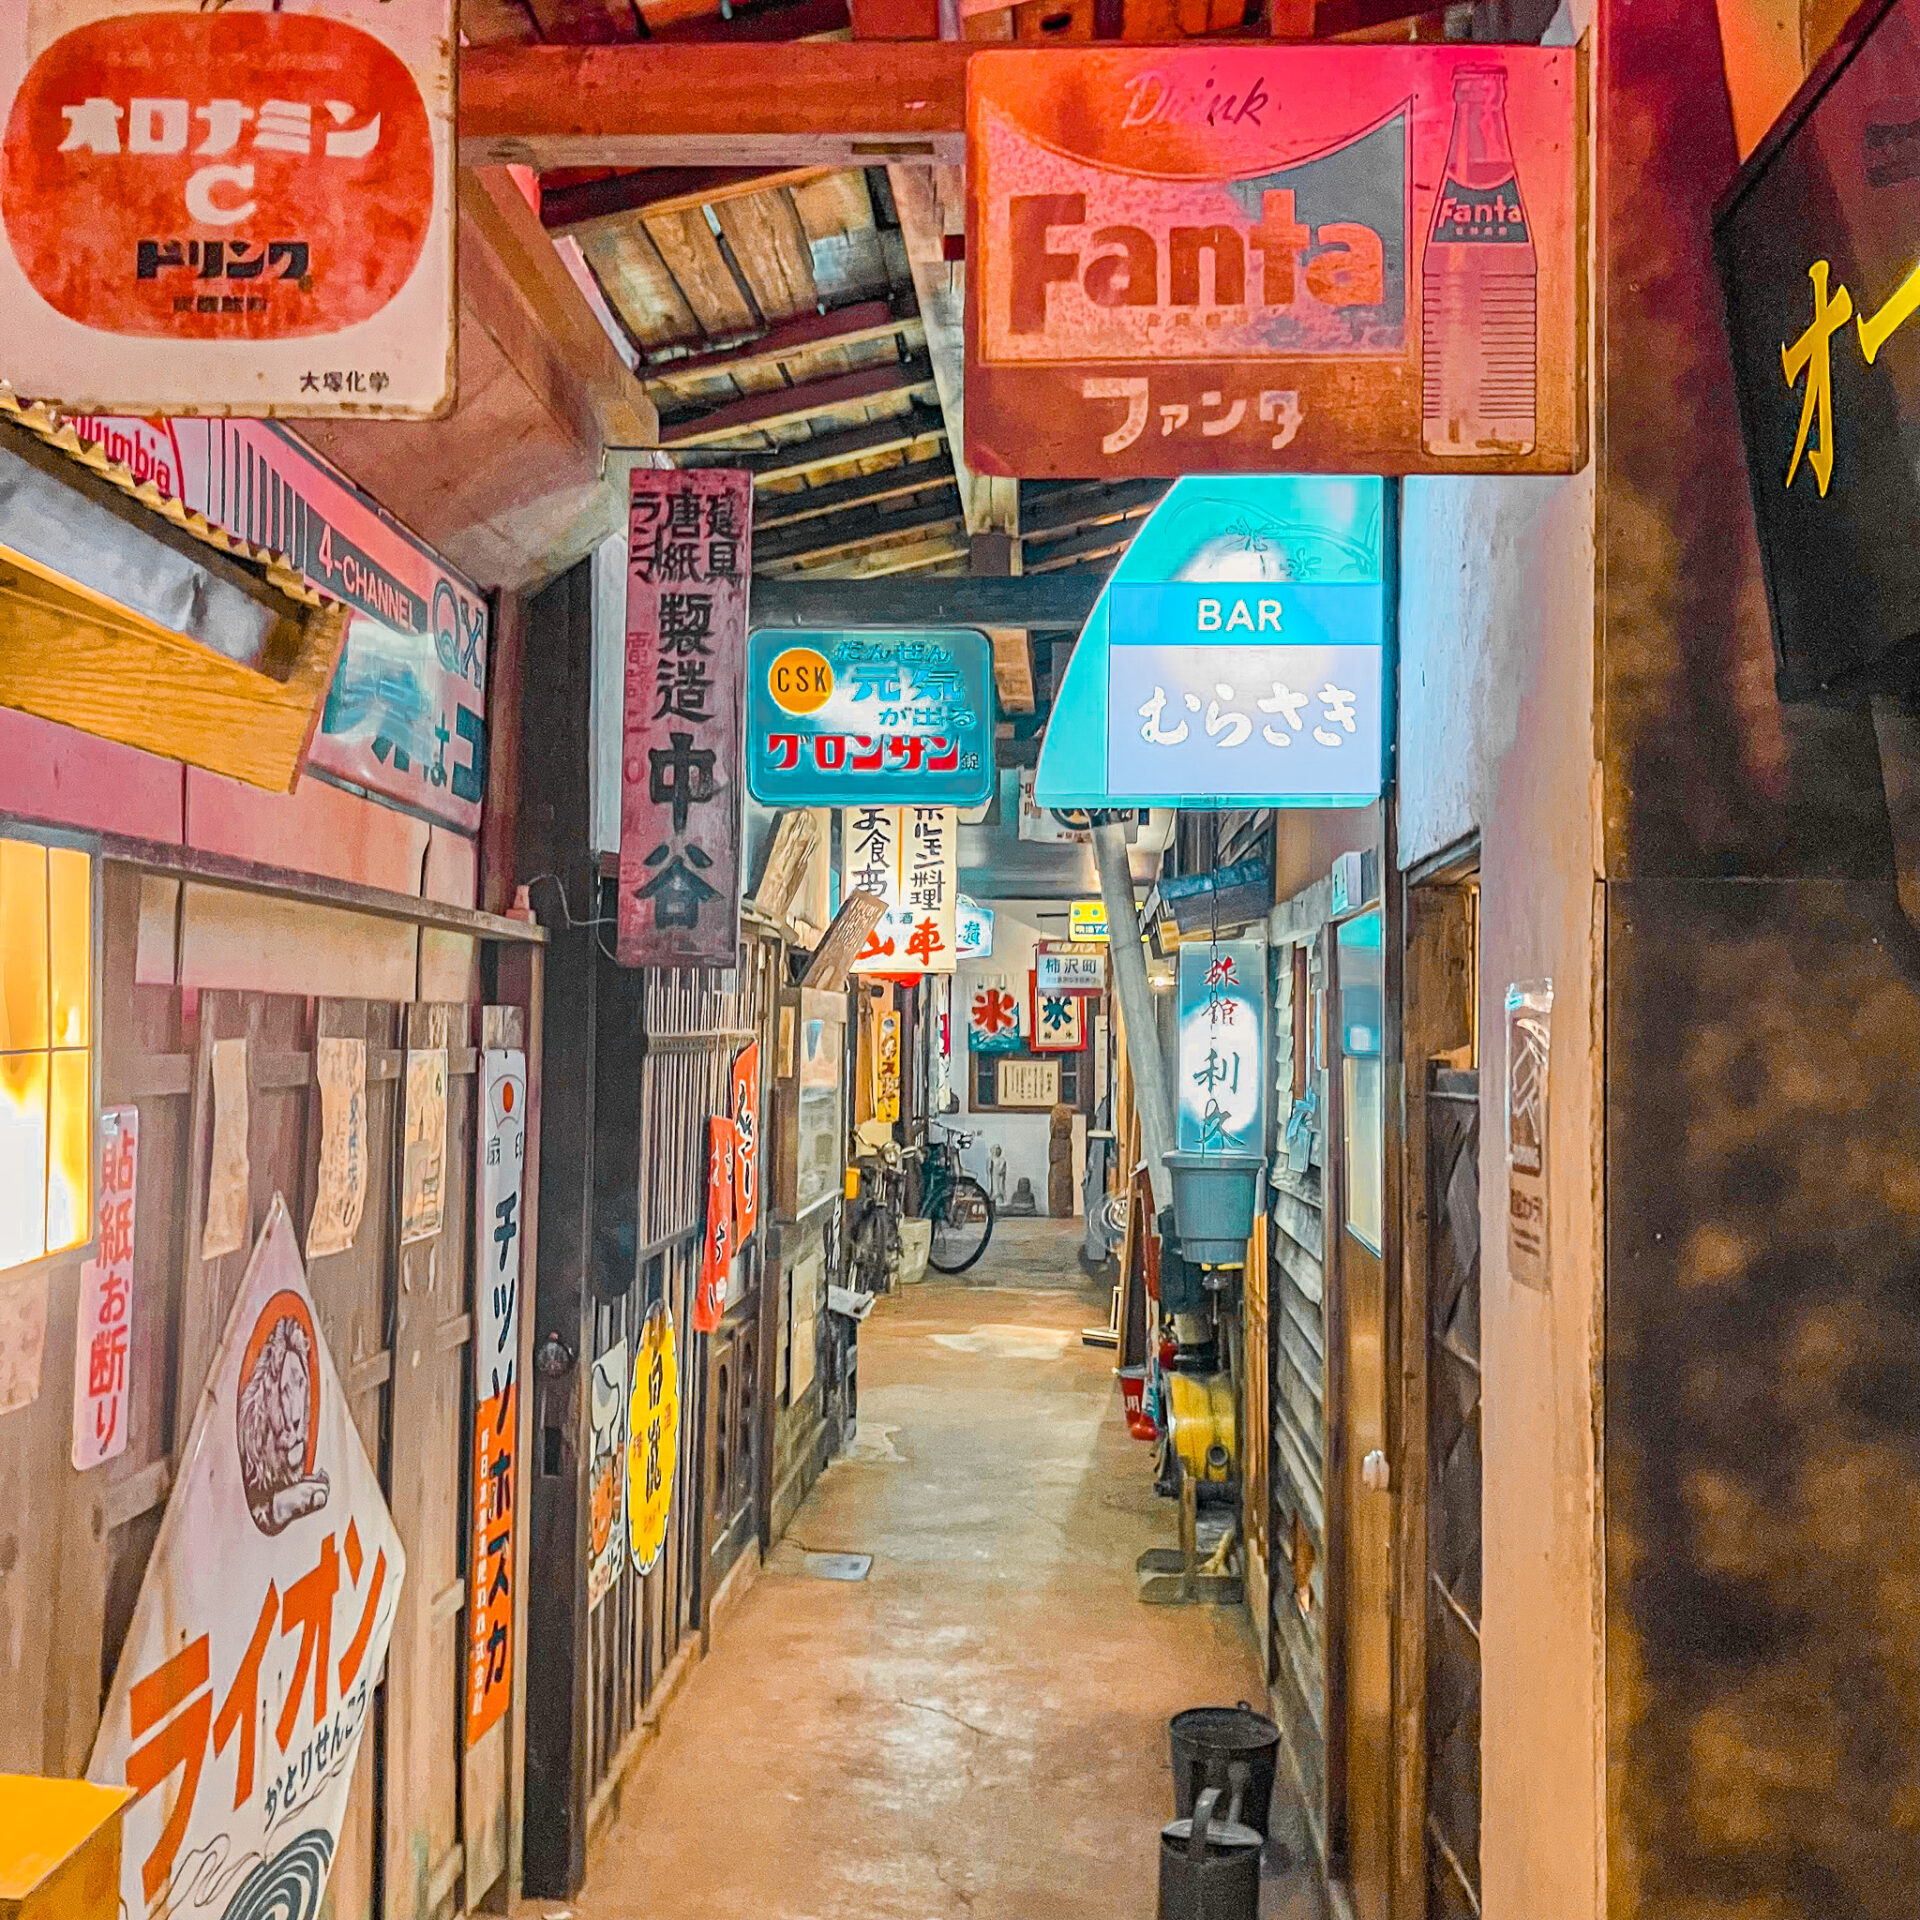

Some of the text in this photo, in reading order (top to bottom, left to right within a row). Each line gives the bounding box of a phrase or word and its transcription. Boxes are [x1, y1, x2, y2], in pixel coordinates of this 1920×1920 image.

[58, 98, 381, 158] オロナミン
[186, 163, 257, 226] C
[1437, 194, 1523, 228] Fanta
[137, 240, 310, 281] ドリンク
[1009, 189, 1384, 334] Fanta
[1082, 378, 1303, 454] ファンタ
[72, 414, 173, 499] lumbia
[318, 523, 420, 634] 4-CHANNEL
[433, 577, 484, 689] QX
[1197, 599, 1283, 632] BAR
[653, 593, 715, 721] 製造
[777, 666, 828, 692] CSK
[835, 640, 951, 663] だんぜん
[851, 665, 965, 702] 元気
[879, 706, 978, 730] が出る
[1137, 682, 1357, 747] むらさき
[632, 732, 728, 930] 中谷
[971, 989, 1015, 1034] 氷
[89, 1128, 136, 1456] 貼紙お断り
[124, 1513, 388, 1906] ライオン
